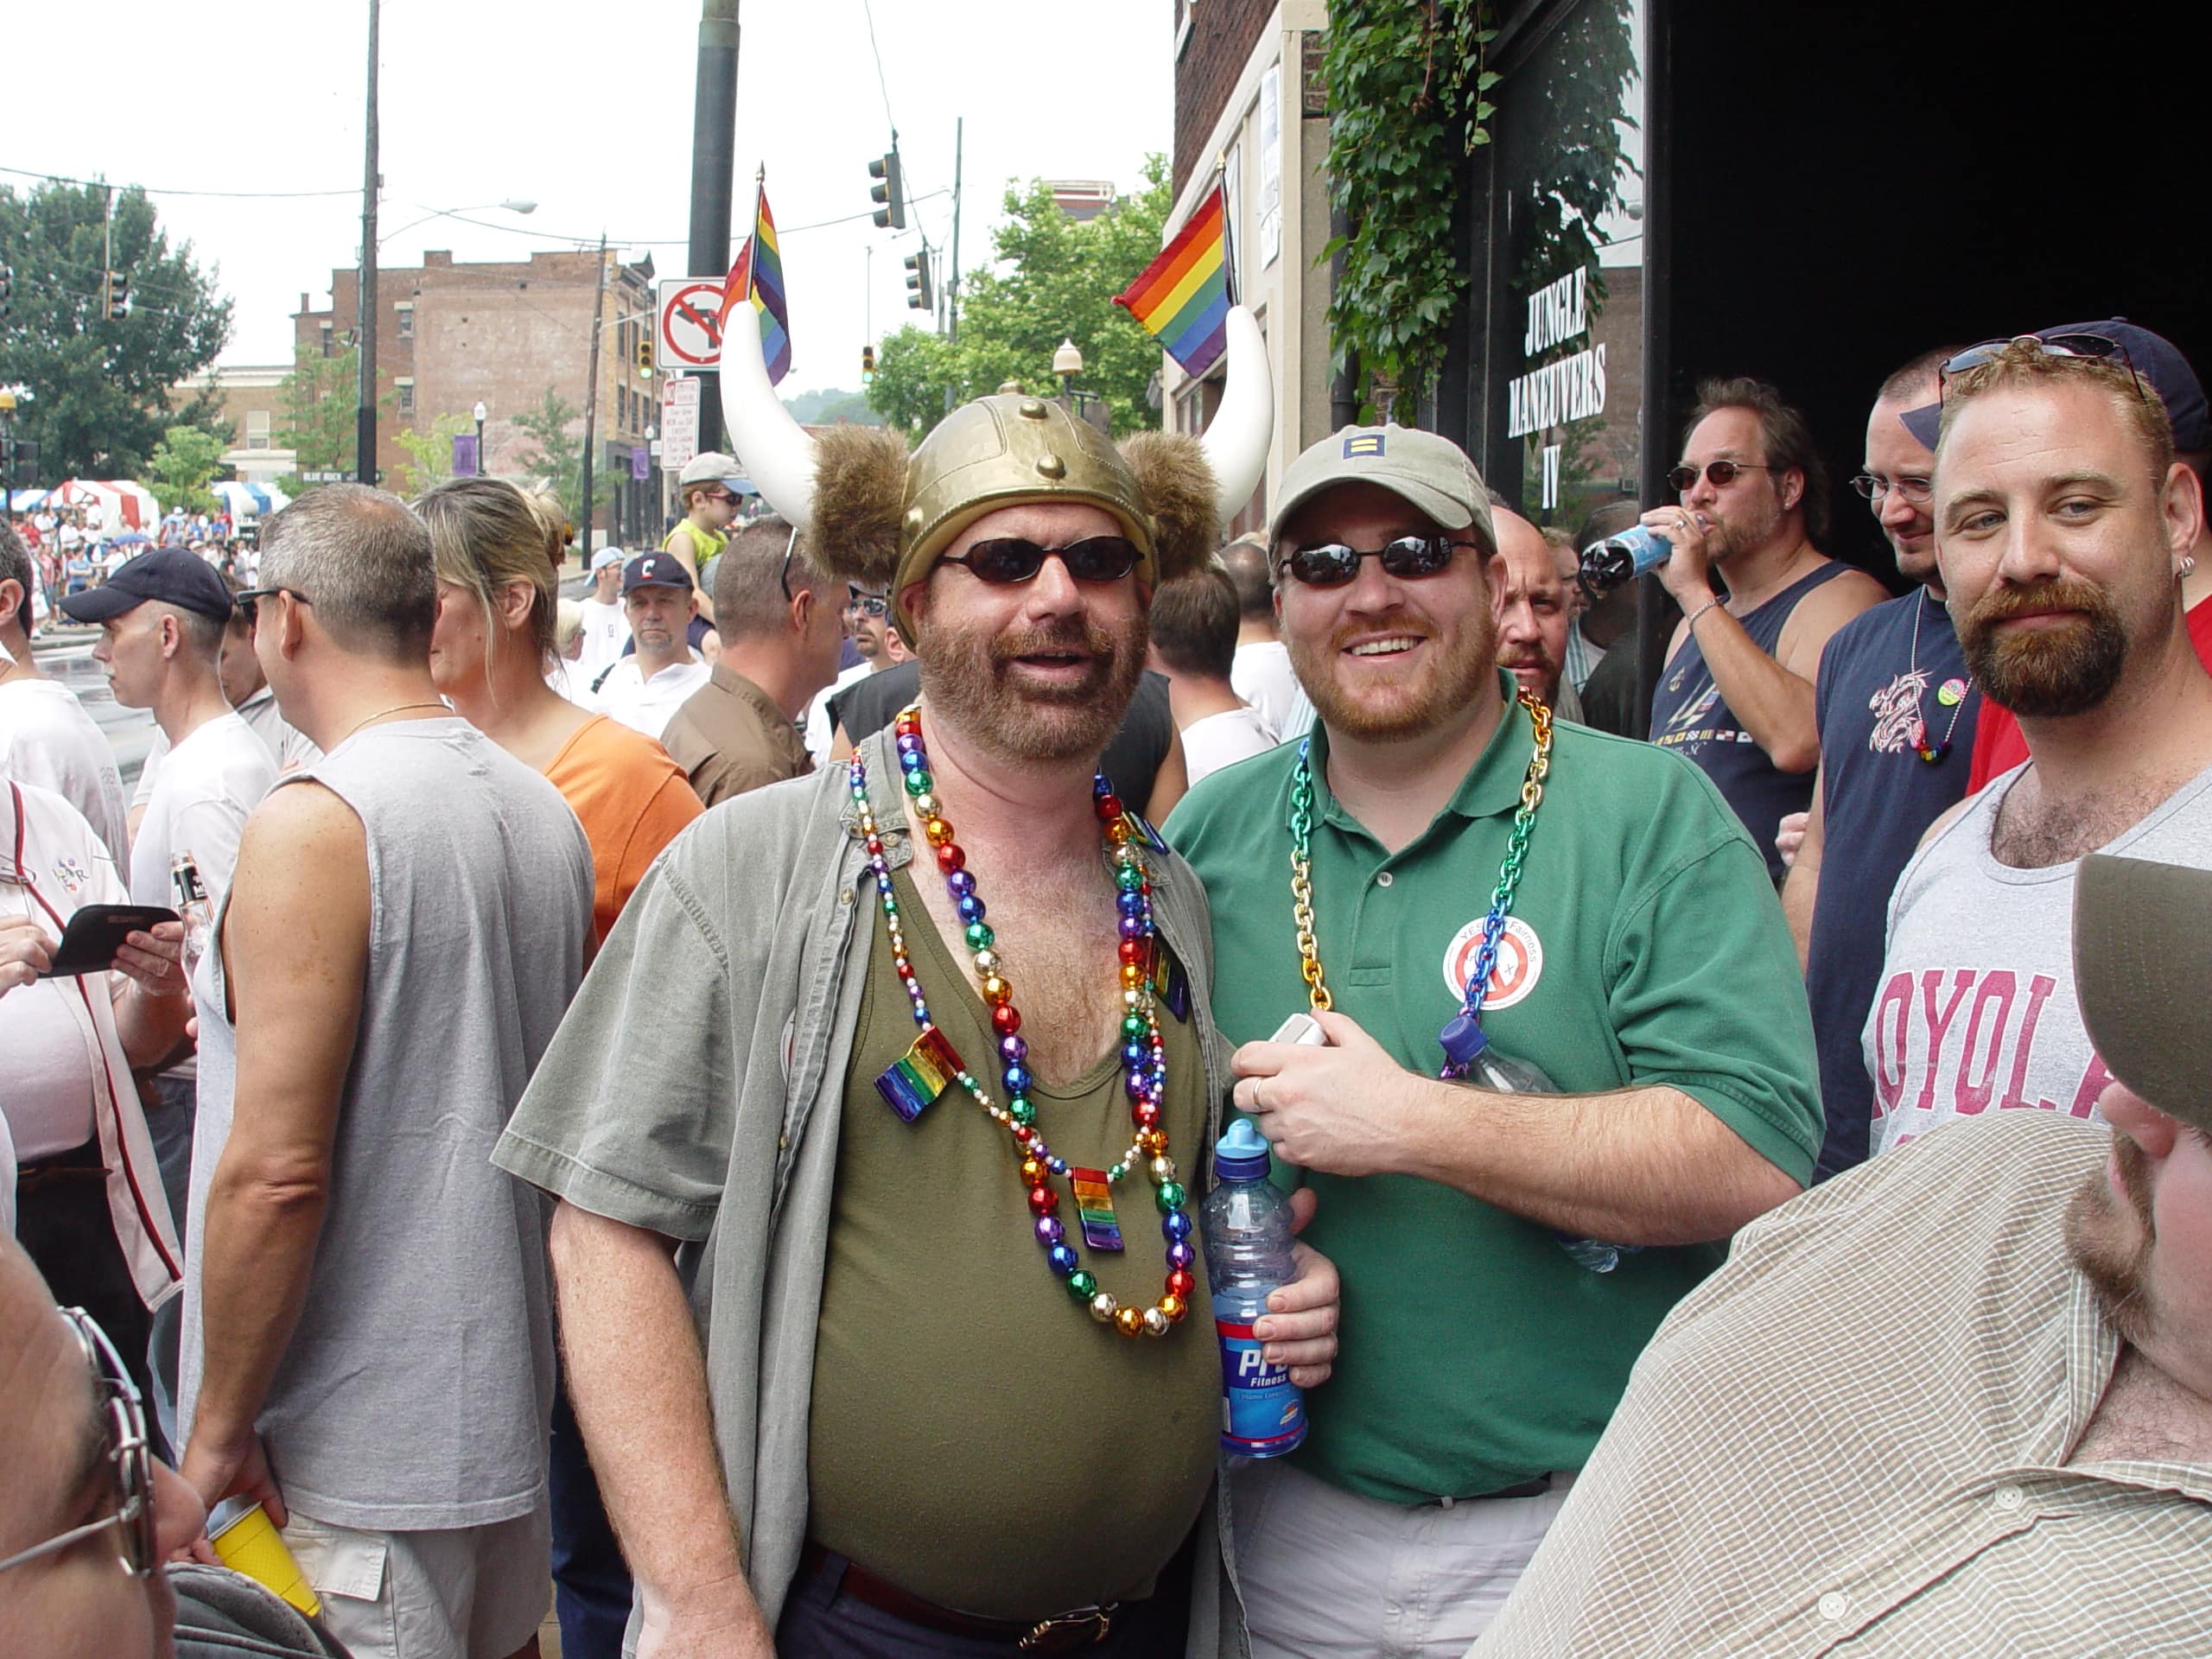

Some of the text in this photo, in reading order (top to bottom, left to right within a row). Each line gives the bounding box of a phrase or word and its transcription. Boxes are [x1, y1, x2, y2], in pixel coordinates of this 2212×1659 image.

[1525, 265, 1586, 358] JUNGLE
[1508, 342, 1605, 439] MANEUVERS
[1541, 443, 1561, 510] IV
[1509, 920, 1537, 963] Fairness
[1872, 969, 2115, 1119] OYOL
[1250, 1374, 1287, 1388] Fitness
